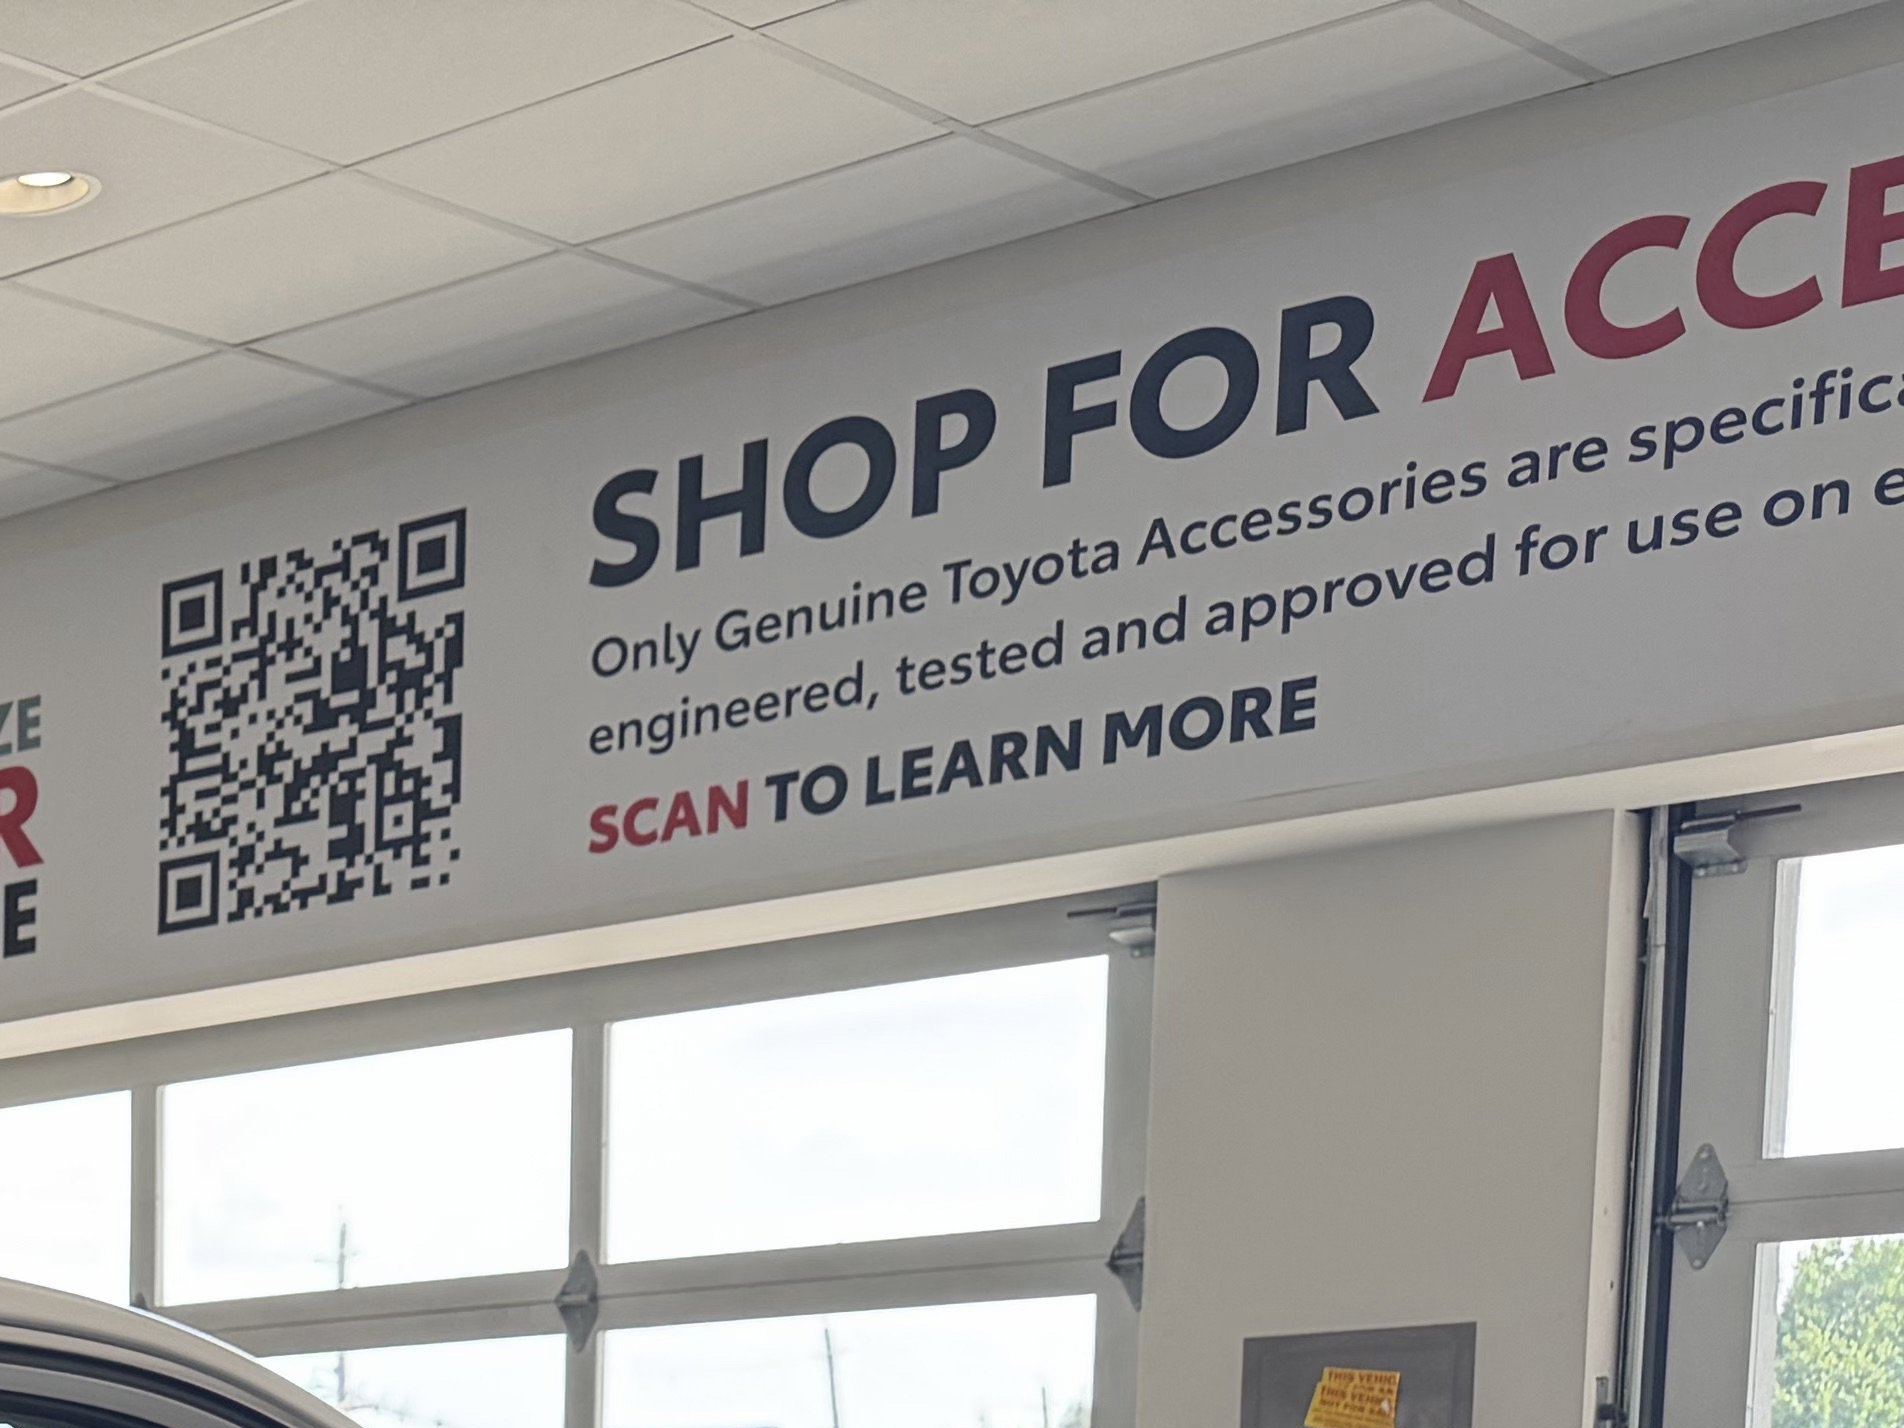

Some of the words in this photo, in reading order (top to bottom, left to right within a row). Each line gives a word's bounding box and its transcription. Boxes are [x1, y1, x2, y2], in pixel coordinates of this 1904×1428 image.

[589, 388, 997, 588] SHOP
[1042, 295, 1381, 489] FOR
[1423, 155, 1904, 402] ACCE
[589, 660, 879, 756] engineered,
[896, 620, 1065, 696] tested
[1082, 595, 1188, 661] and
[1205, 533, 1495, 642] approved
[1515, 524, 1608, 577] for
[1628, 500, 1743, 555] use
[1762, 478, 1850, 528] on
[593, 622, 701, 678] Only
[716, 580, 928, 653] Genuine
[944, 538, 1121, 606] Toyota
[1137, 460, 1487, 565] Accessories
[1507, 433, 1608, 488] are
[1628, 366, 1904, 470] specific
[588, 780, 750, 855] SCAN
[765, 765, 848, 823] TO
[864, 719, 1083, 807] LEARN
[1103, 675, 1318, 765] MORE
